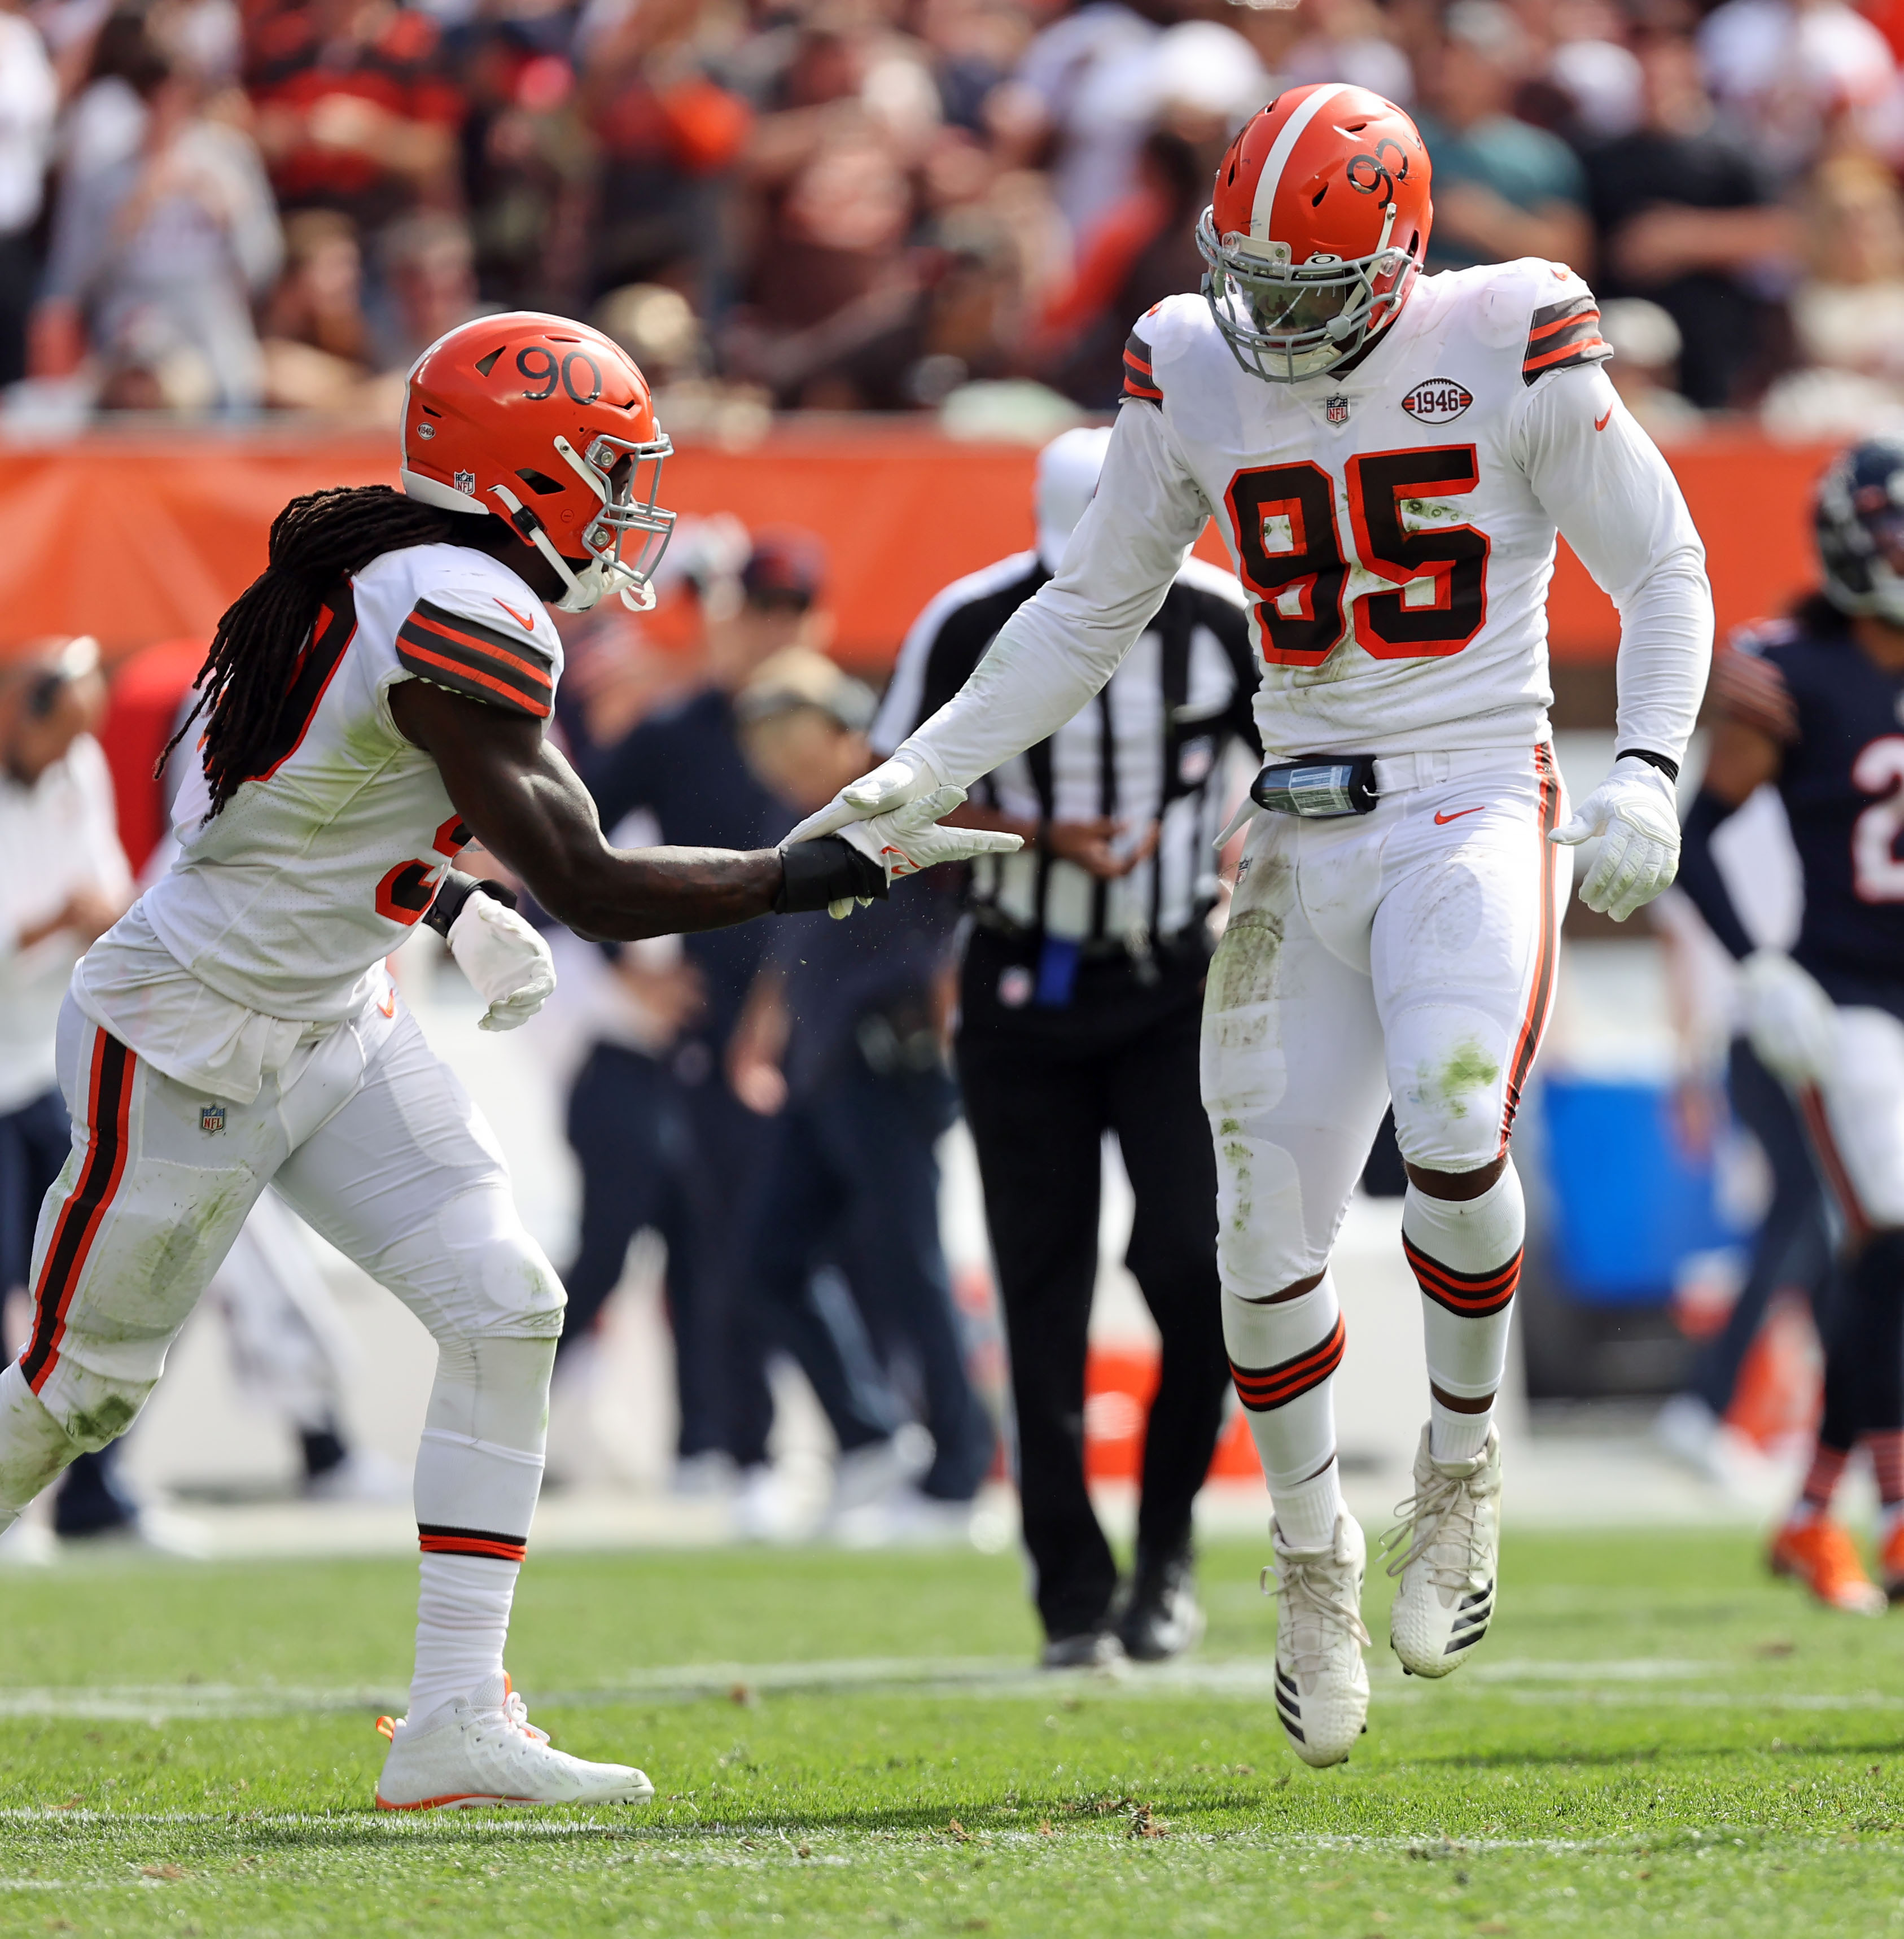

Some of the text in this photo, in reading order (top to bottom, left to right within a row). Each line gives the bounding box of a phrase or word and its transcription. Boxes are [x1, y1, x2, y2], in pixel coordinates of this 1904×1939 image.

[516, 346, 602, 405] 90
[1416, 389, 1459, 413] 1946
[1328, 408, 1346, 421] NFL
[458, 481, 472, 493] NFL
[1224, 443, 1491, 667] 95
[204, 1118, 222, 1130] NFL
